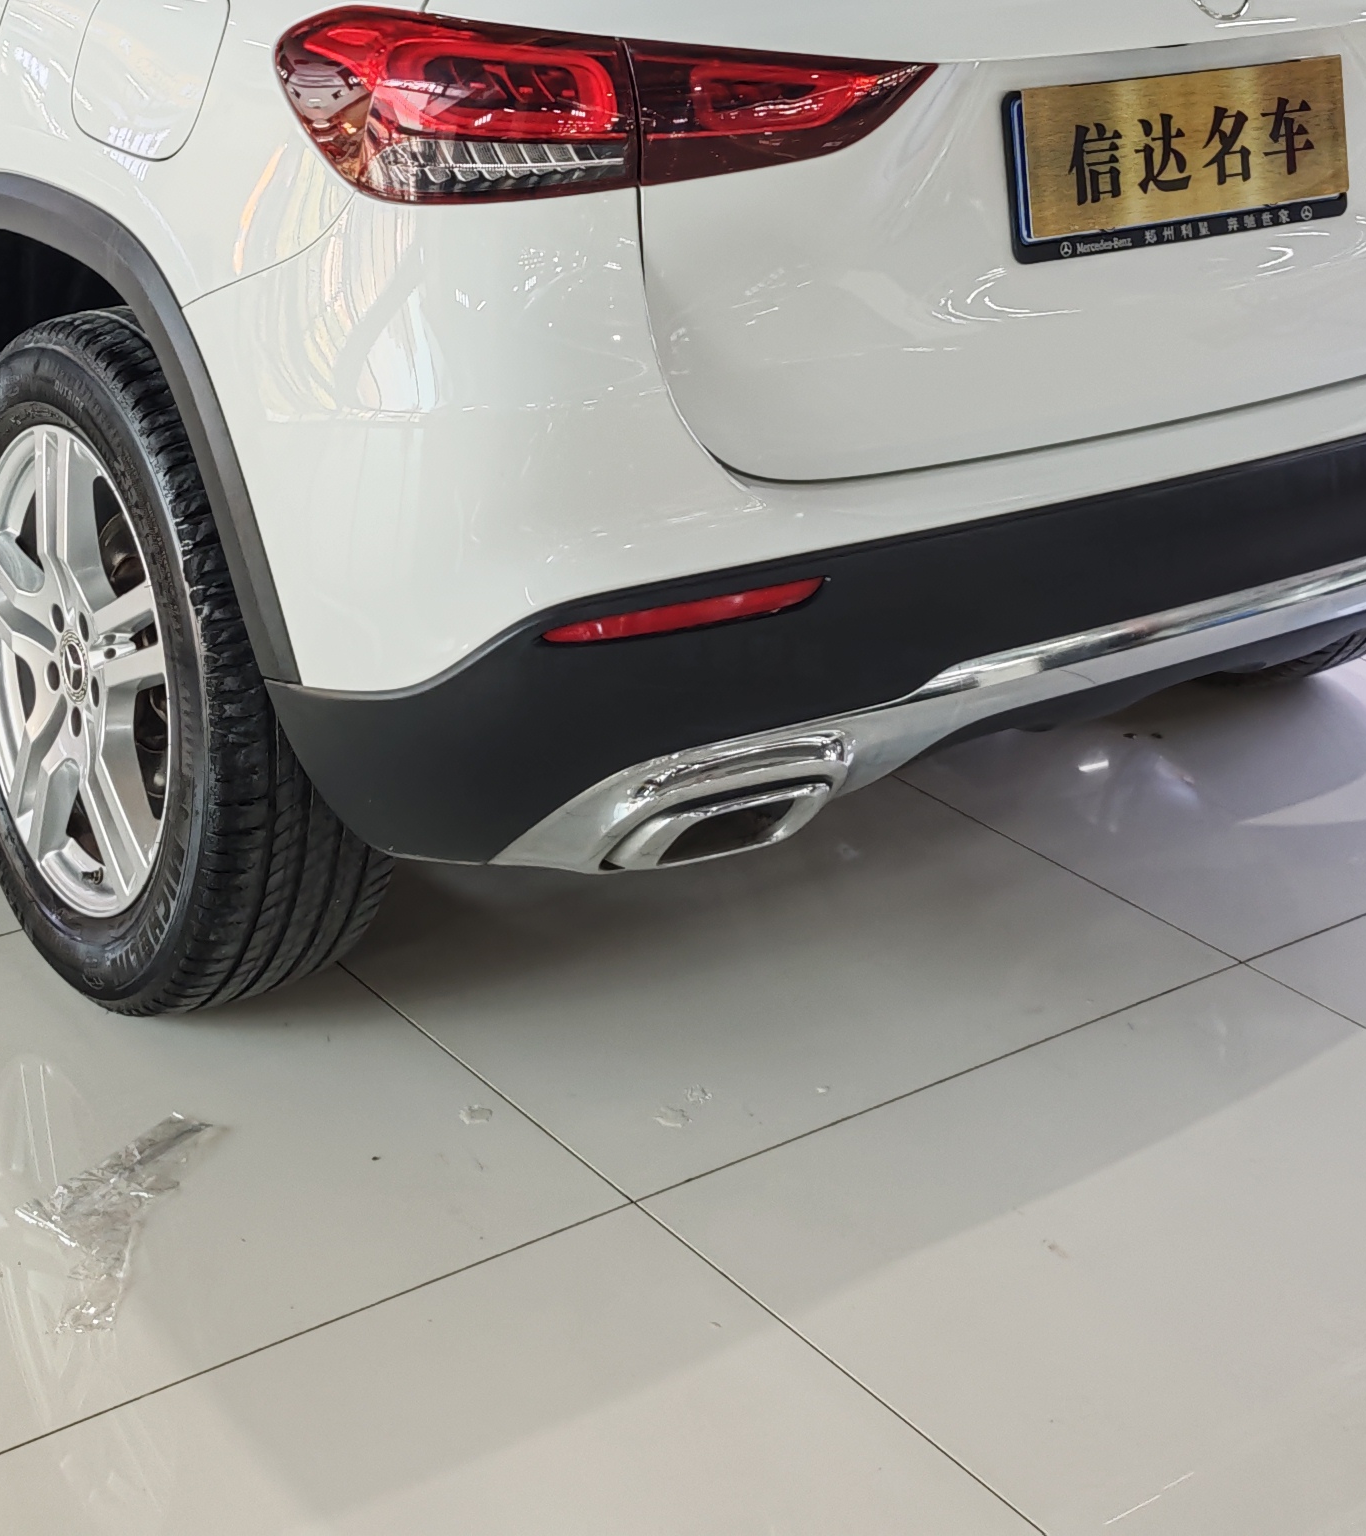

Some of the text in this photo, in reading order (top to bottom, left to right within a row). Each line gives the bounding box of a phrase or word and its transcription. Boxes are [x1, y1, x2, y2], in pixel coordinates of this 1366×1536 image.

[1067, 96, 1316, 207] 信达名车
[1075, 236, 1133, 256] Mercedes-Benz
